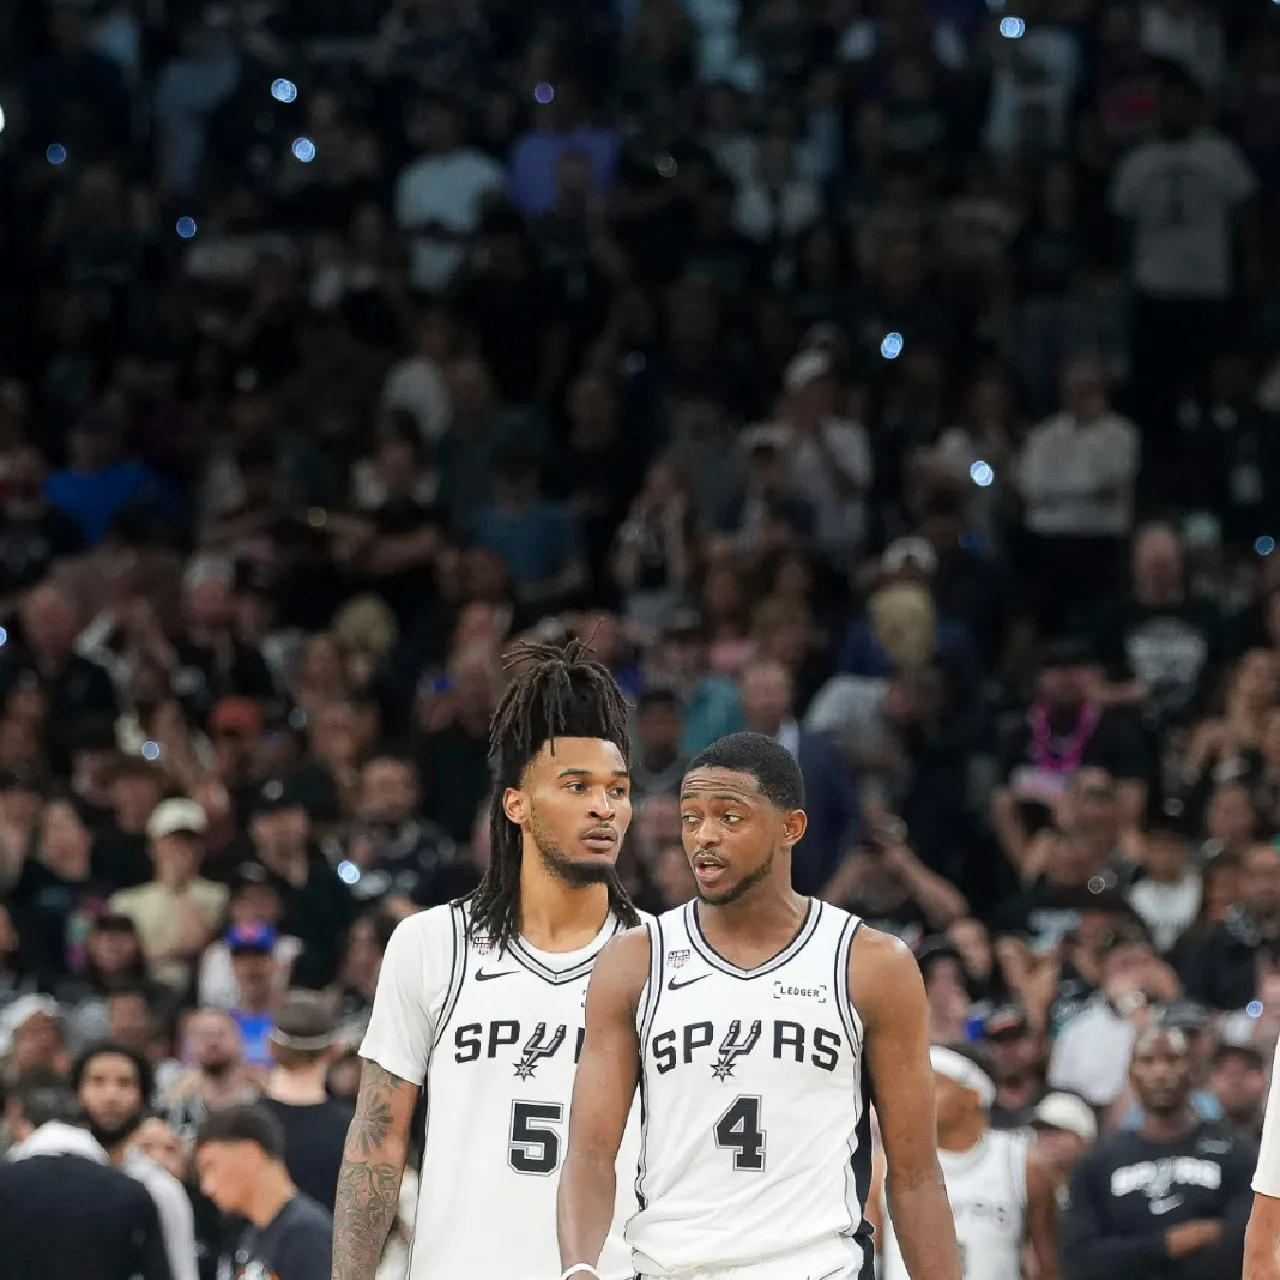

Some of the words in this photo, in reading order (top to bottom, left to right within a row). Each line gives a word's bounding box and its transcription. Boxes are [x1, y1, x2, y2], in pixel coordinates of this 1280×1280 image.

[780, 986, 819, 997] LEDGER
[455, 1020, 585, 1082] SPU
[652, 1020, 841, 1083] SPURS
[507, 1099, 564, 1177] 5
[713, 1094, 766, 1172] 4
